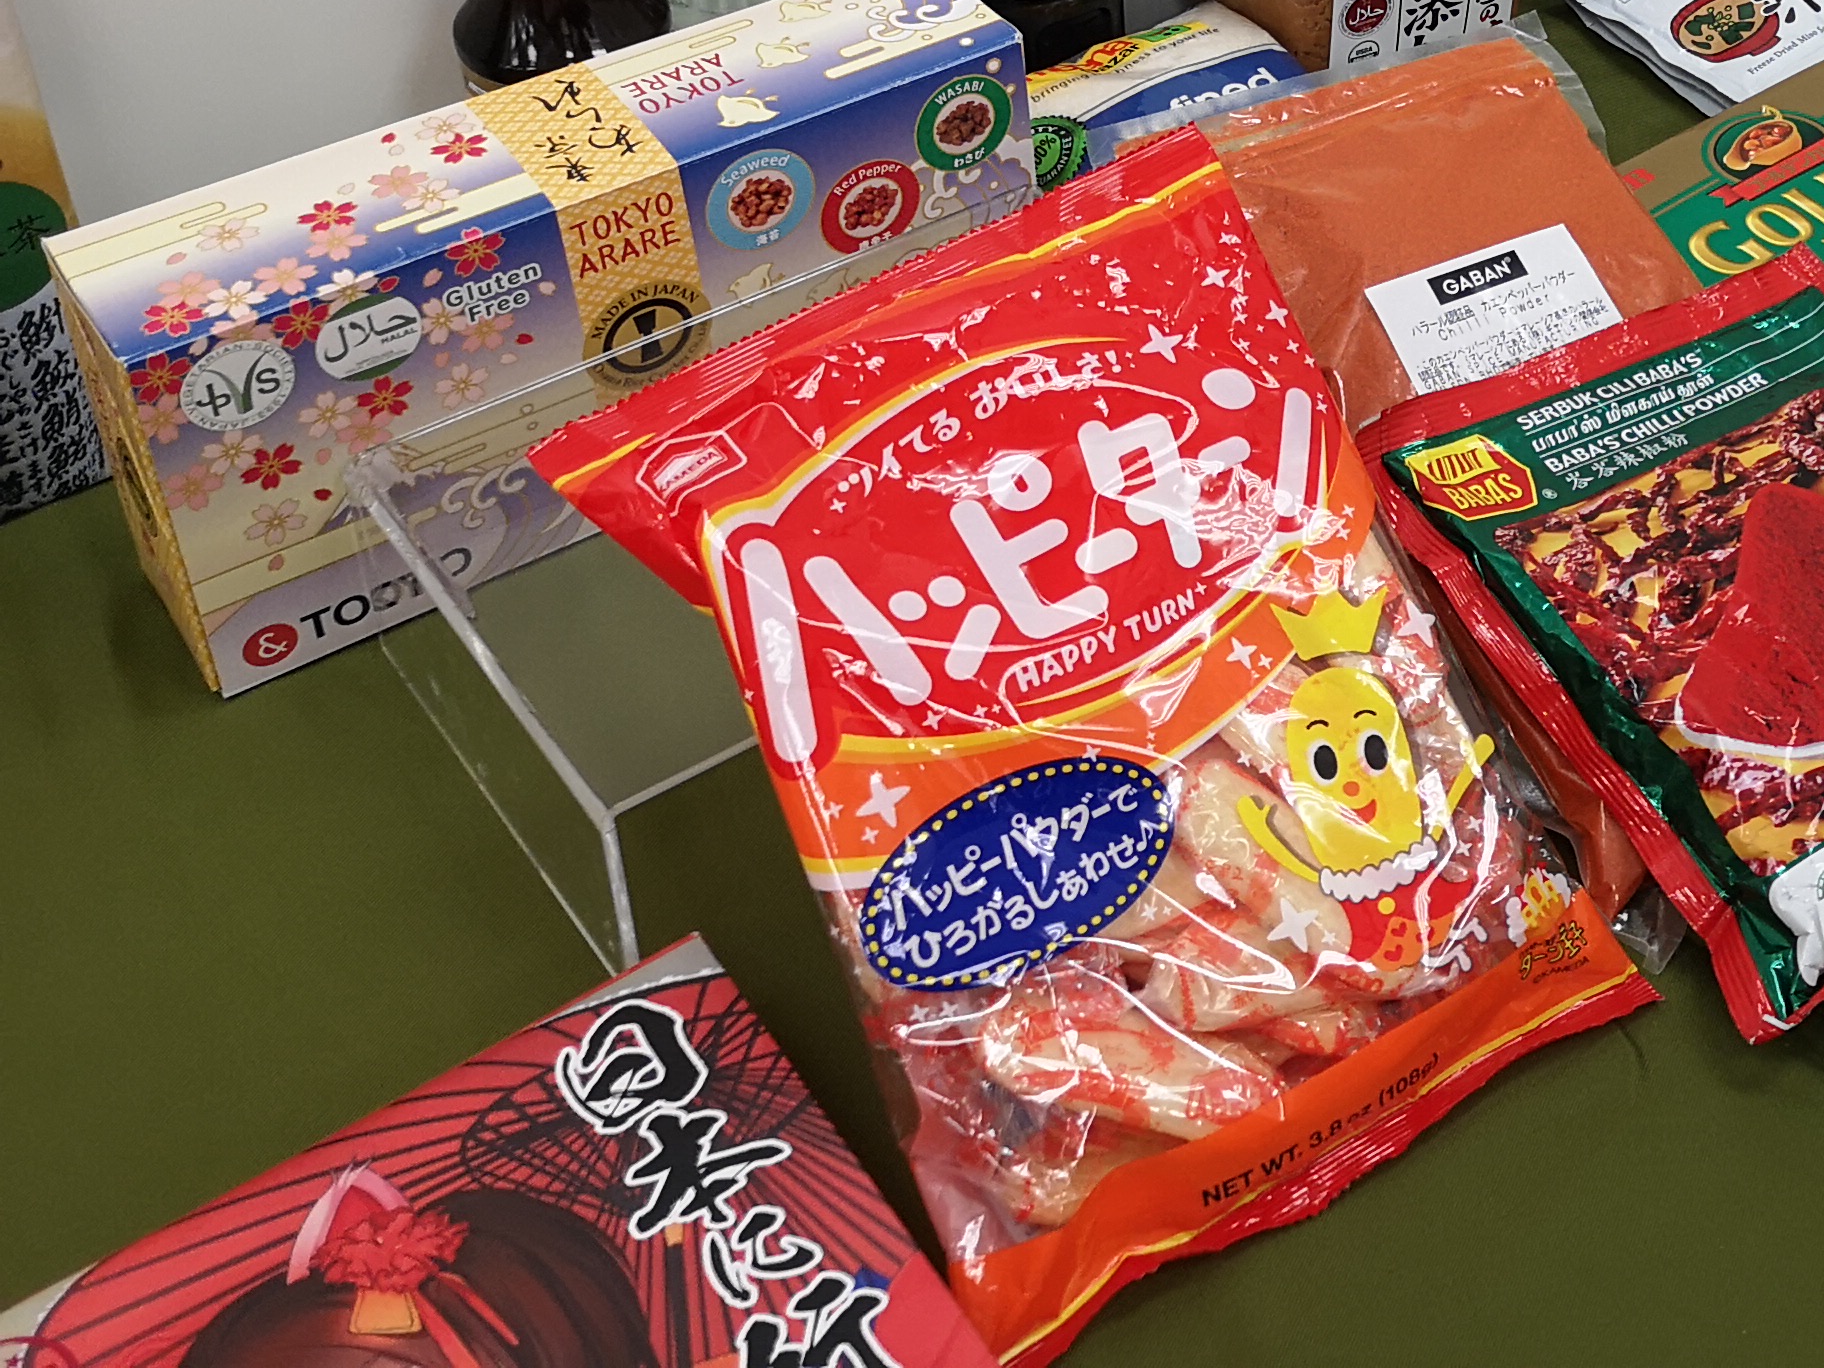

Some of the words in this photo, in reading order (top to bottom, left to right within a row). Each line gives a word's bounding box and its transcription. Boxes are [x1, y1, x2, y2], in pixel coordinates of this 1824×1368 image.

[620, 52, 725, 99] ARARE
[1030, 70, 1092, 104] bringing
[1152, 42, 1168, 55] to
[1165, 34, 1199, 52] your
[1197, 26, 1222, 38] life
[1746, 53, 1775, 76] Freeze
[1772, 42, 1799, 64] Dried
[1796, 33, 1820, 53] Miso
[637, 69, 745, 114] TOKYO
[933, 80, 986, 107] WASABI
[720, 154, 792, 188] Seaweed
[832, 173, 859, 197] Red
[857, 162, 903, 182] Pepper
[952, 146, 987, 169] わさび
[569, 191, 675, 247] TOKYO
[579, 220, 682, 280] ARARE
[444, 262, 540, 309] Gluten
[1441, 255, 1512, 297] GABAN
[465, 288, 531, 326] Free
[591, 296, 632, 341] MADE
[630, 287, 650, 303] IN
[651, 283, 700, 305] JAPAN
[1410, 304, 1477, 338] ハラール認証品
[1479, 269, 1577, 314] カエンペッパーパウダー
[1436, 313, 1492, 343] Chilli
[1498, 294, 1552, 320] Powder
[380, 325, 419, 346] HALAL
[1516, 390, 1598, 432] SERBUK
[1596, 376, 1636, 401] CILI
[1632, 350, 1704, 388] BABA'S
[1542, 438, 1622, 475] BABA'S
[1619, 412, 1685, 449] CHILLI
[1685, 371, 1771, 419] POWDER
[1443, 471, 1525, 512] BABA'S
[1015, 622, 1122, 694] HAPPY
[887, 781, 1144, 933] ハッピーパウダーで
[1202, 1168, 1254, 1208] NET
[1261, 1143, 1304, 1177] WT.
[1309, 1118, 1344, 1150] 3.8
[1378, 1052, 1441, 1108] (108g)
